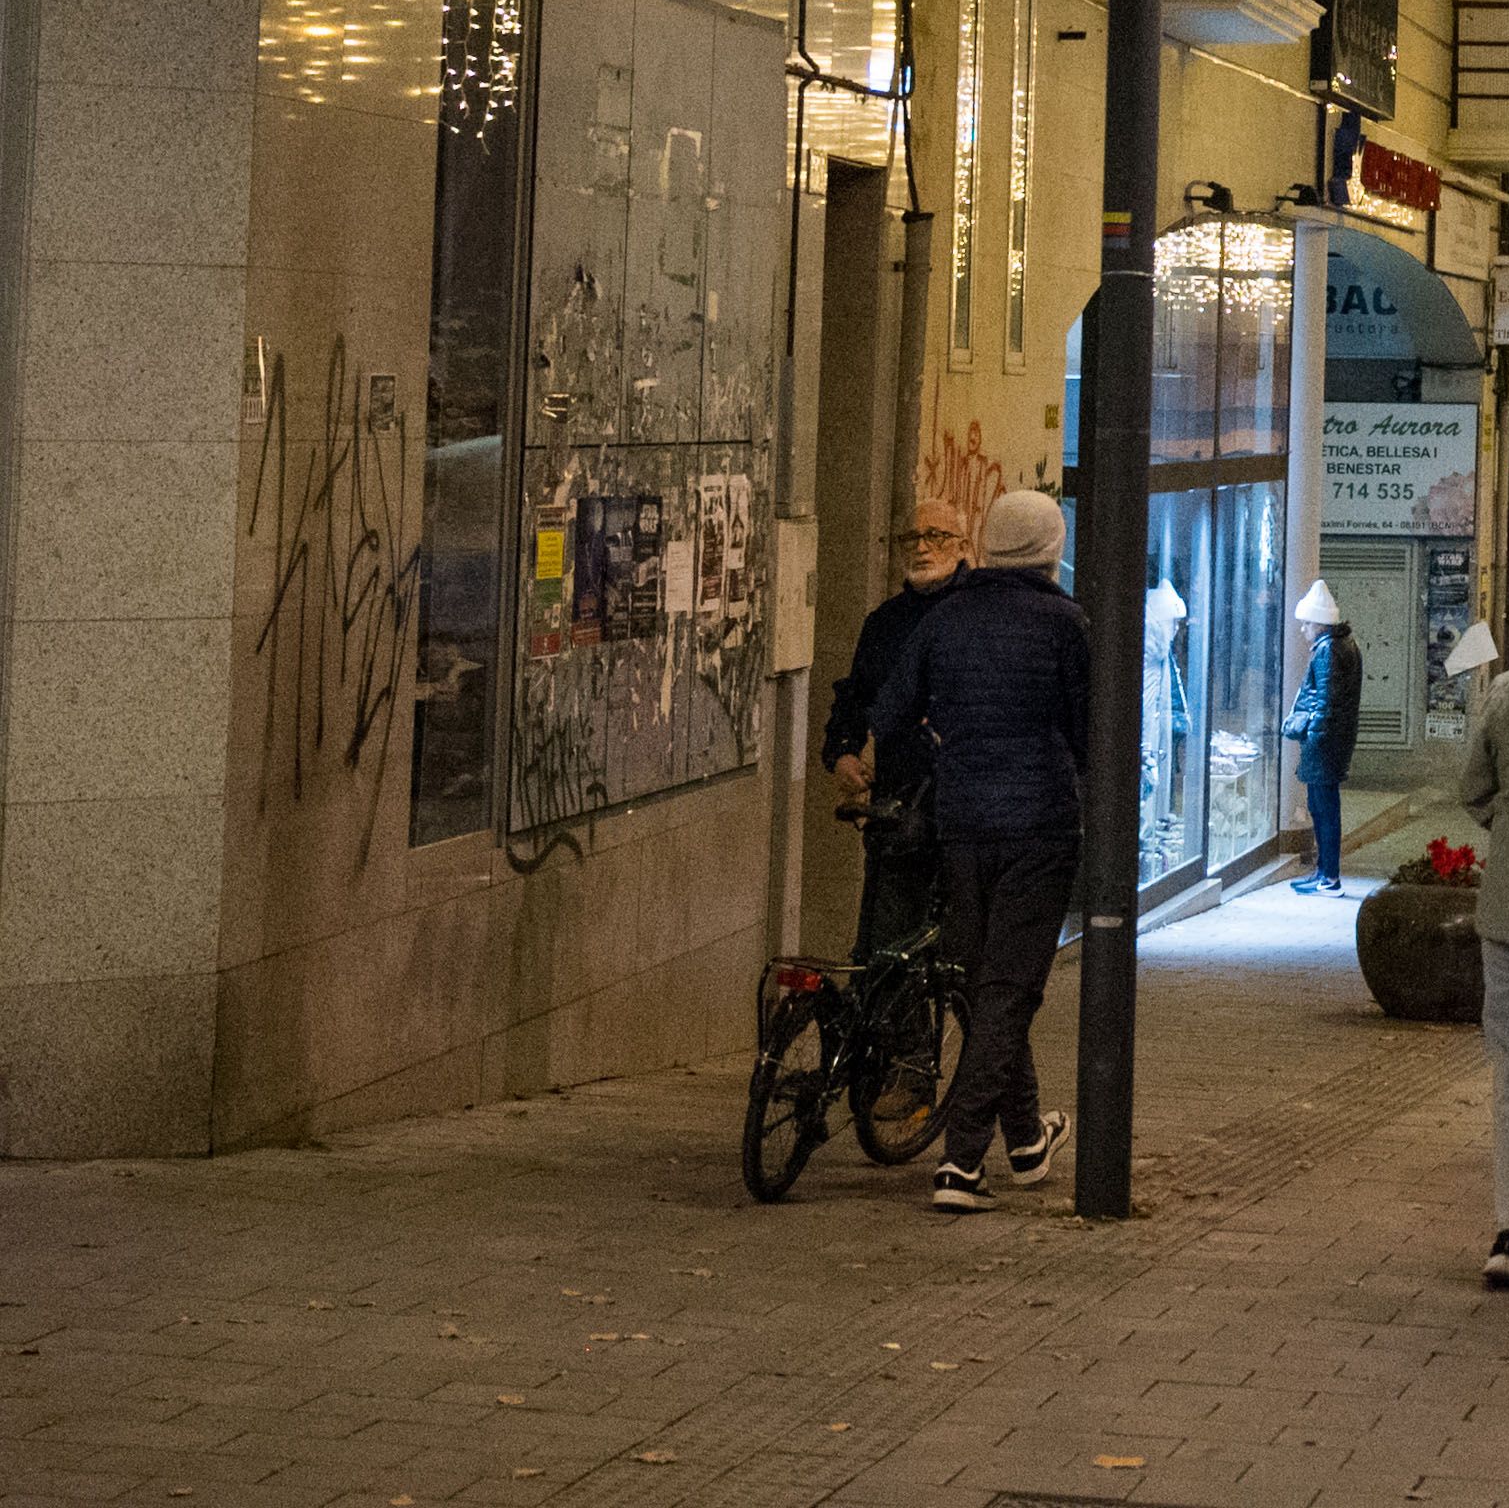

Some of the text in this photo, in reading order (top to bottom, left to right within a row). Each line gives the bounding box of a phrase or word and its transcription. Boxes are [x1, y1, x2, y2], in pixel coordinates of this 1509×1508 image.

[1368, 414, 1462, 436] Aurora
[1366, 446, 1431, 459] BELLESA
[1433, 447, 1438, 459] I
[1326, 462, 1401, 475] BENESTAR
[1333, 483, 1414, 500] 714 535
